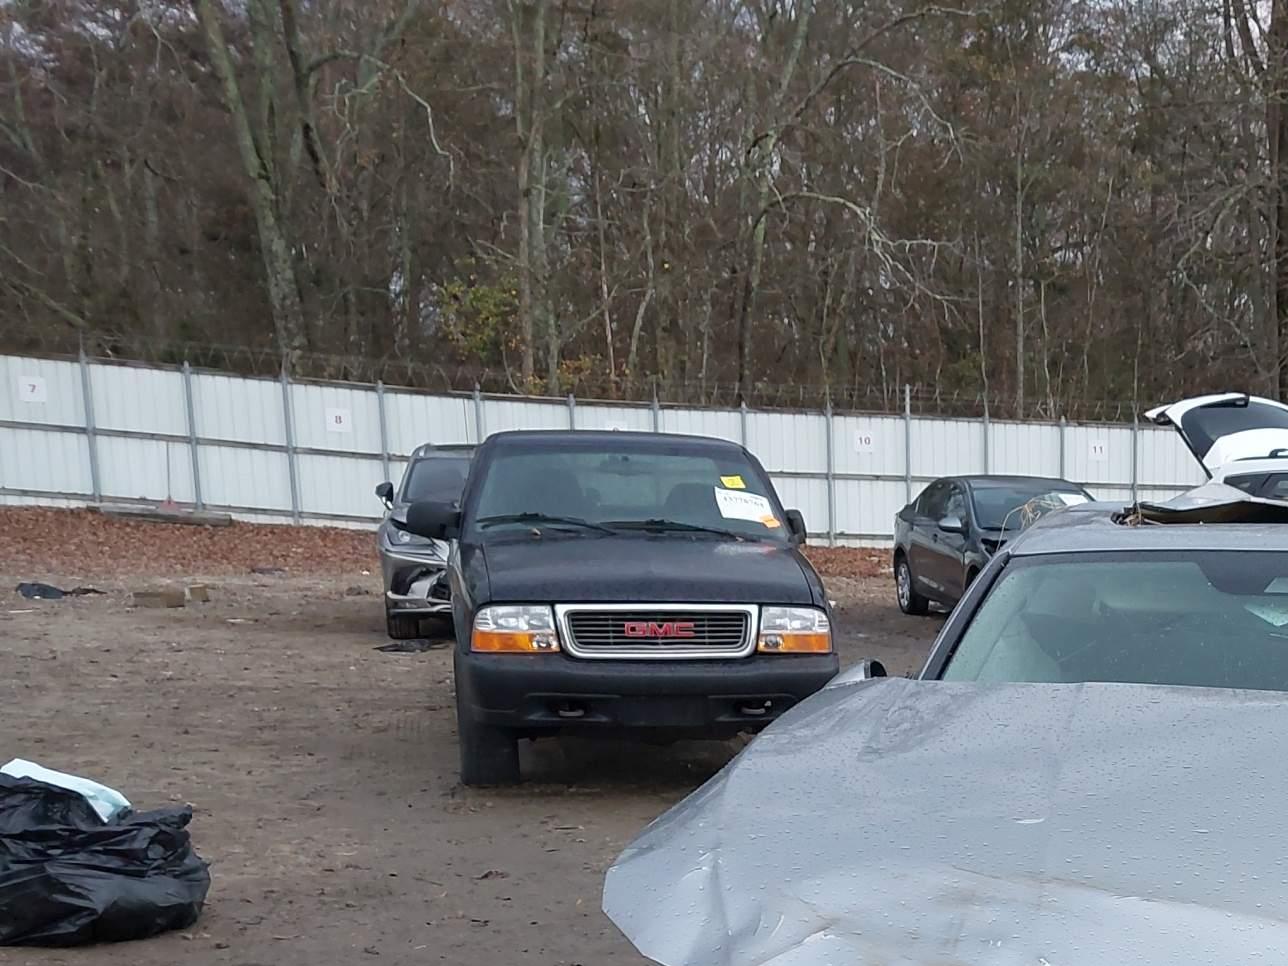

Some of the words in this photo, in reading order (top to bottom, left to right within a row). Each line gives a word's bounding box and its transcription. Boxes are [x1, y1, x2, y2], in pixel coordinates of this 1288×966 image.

[28, 383, 36, 393] 7
[335, 415, 343, 424] 8
[859, 436, 871, 445] 10
[1093, 445, 1104, 454] 11
[624, 621, 696, 638] GMC
